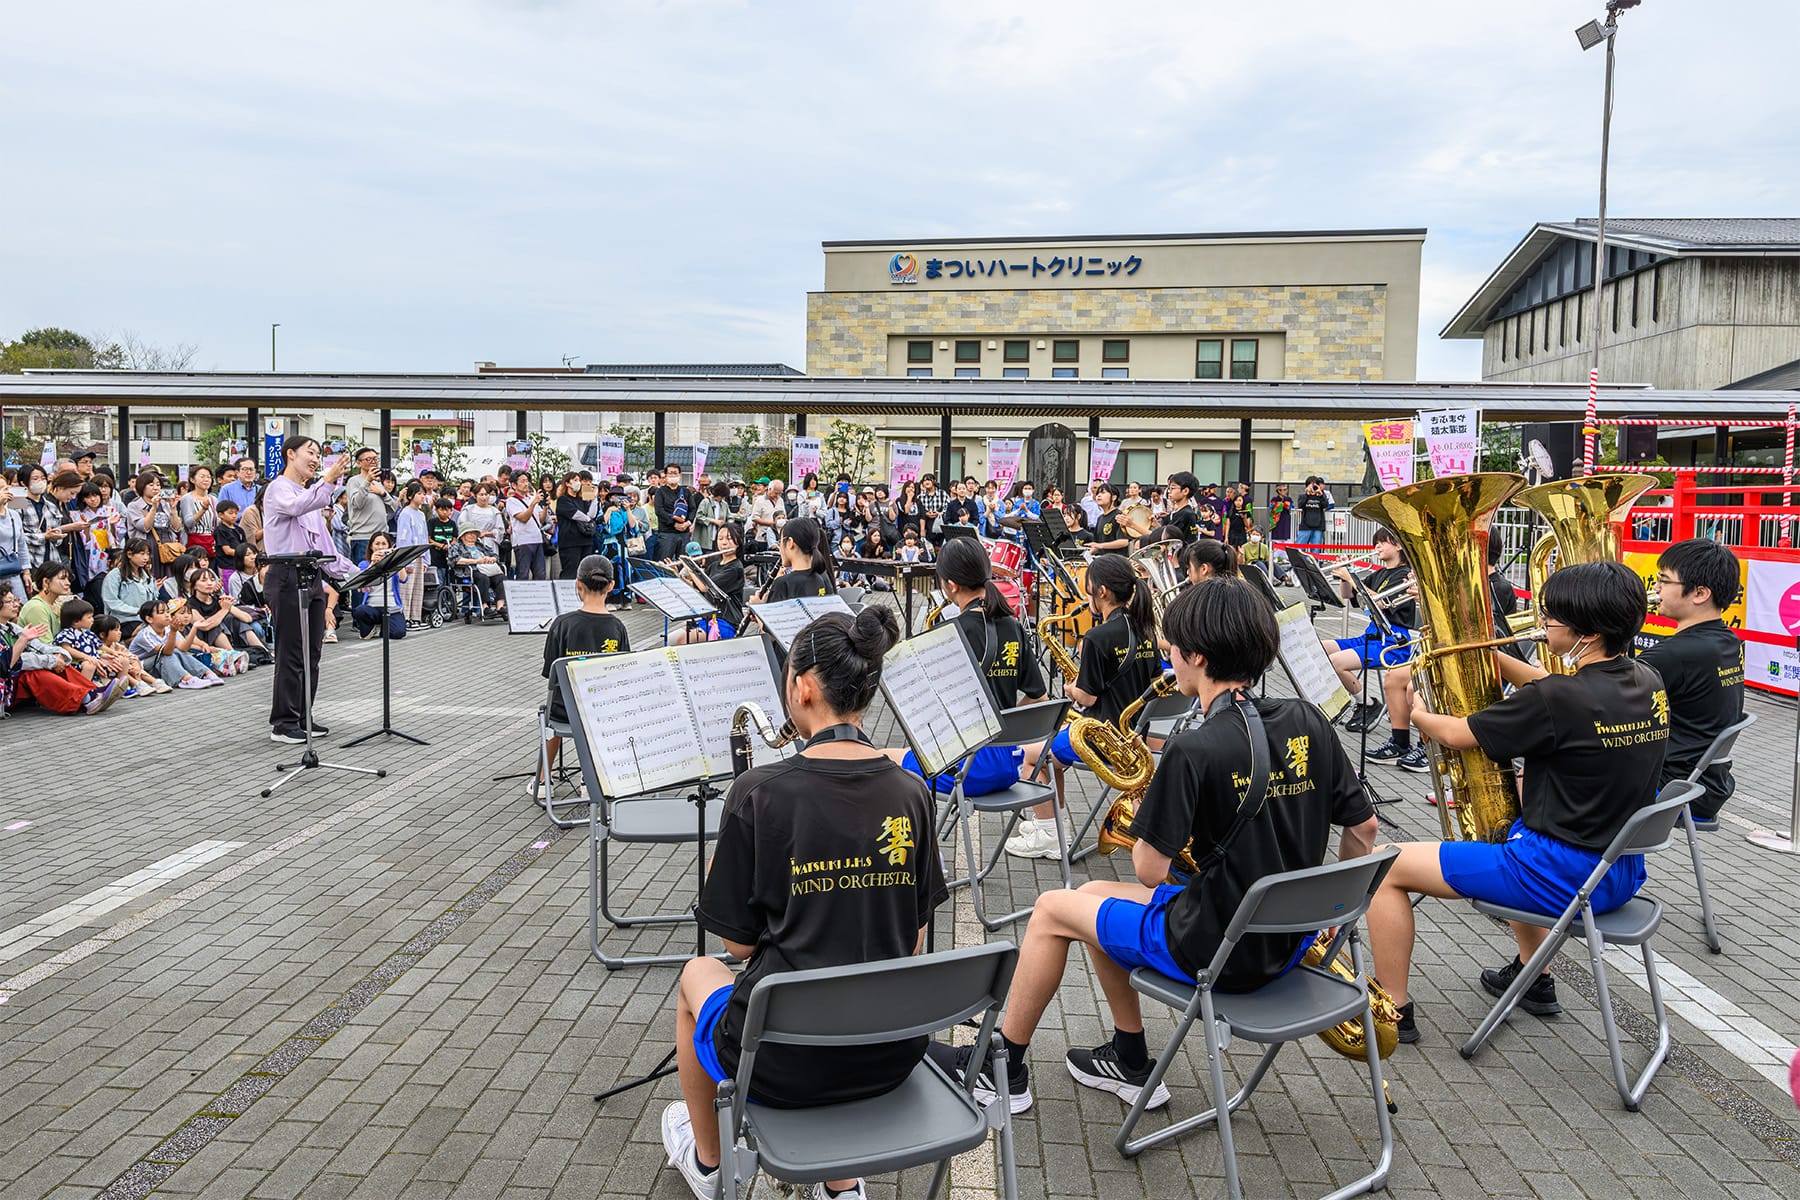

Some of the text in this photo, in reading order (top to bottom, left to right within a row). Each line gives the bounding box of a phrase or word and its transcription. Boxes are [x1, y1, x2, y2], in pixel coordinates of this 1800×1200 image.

[925, 255, 1143, 279] まついハートクリニック
[1001, 641, 1019, 666] 響
[1651, 690, 1670, 726] 響
[1601, 728, 1670, 748] WIND ORCHEST
[1285, 735, 1309, 778] 響
[876, 816, 915, 866] 響
[790, 856, 872, 876] IWATSUKI J.H.S
[791, 877, 834, 896] WIND
